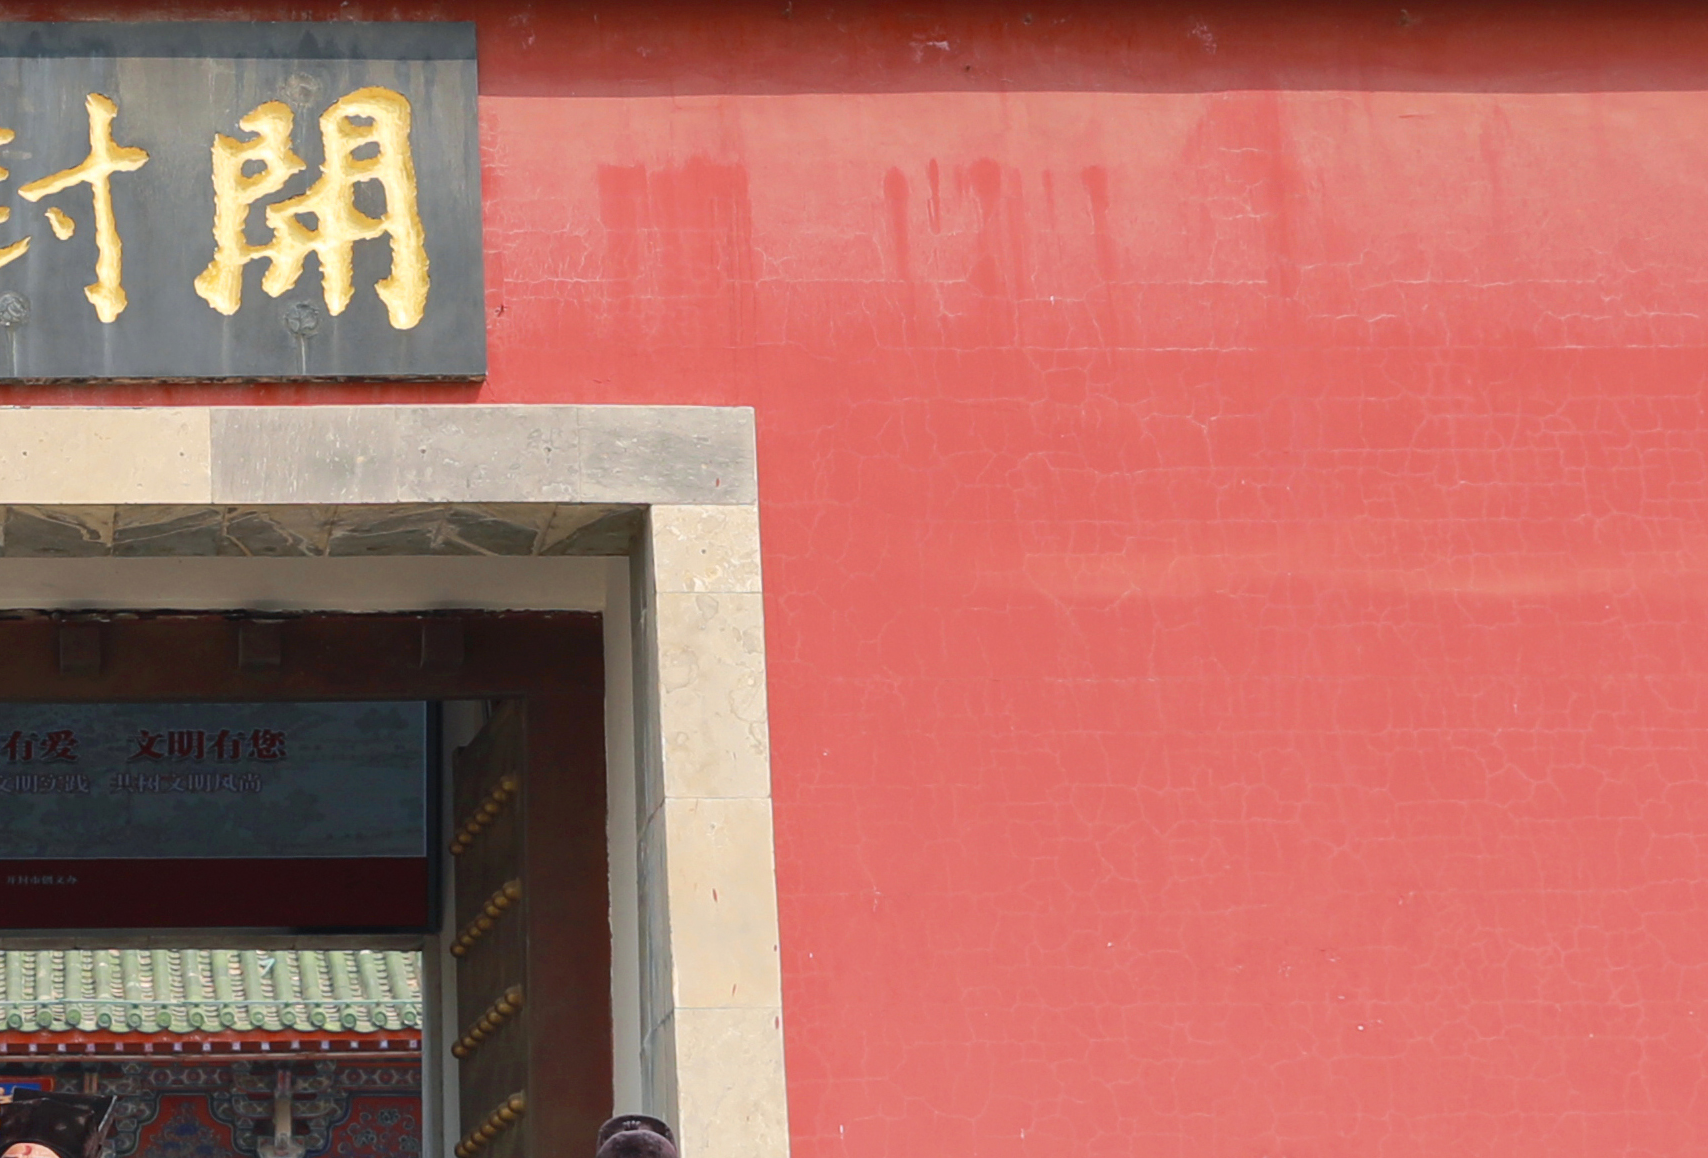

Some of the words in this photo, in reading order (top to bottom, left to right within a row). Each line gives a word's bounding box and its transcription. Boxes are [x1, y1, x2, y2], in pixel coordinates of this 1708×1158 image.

[127, 729, 289, 762] 文明有您
[109, 772, 262, 794] 共树文明风尚
